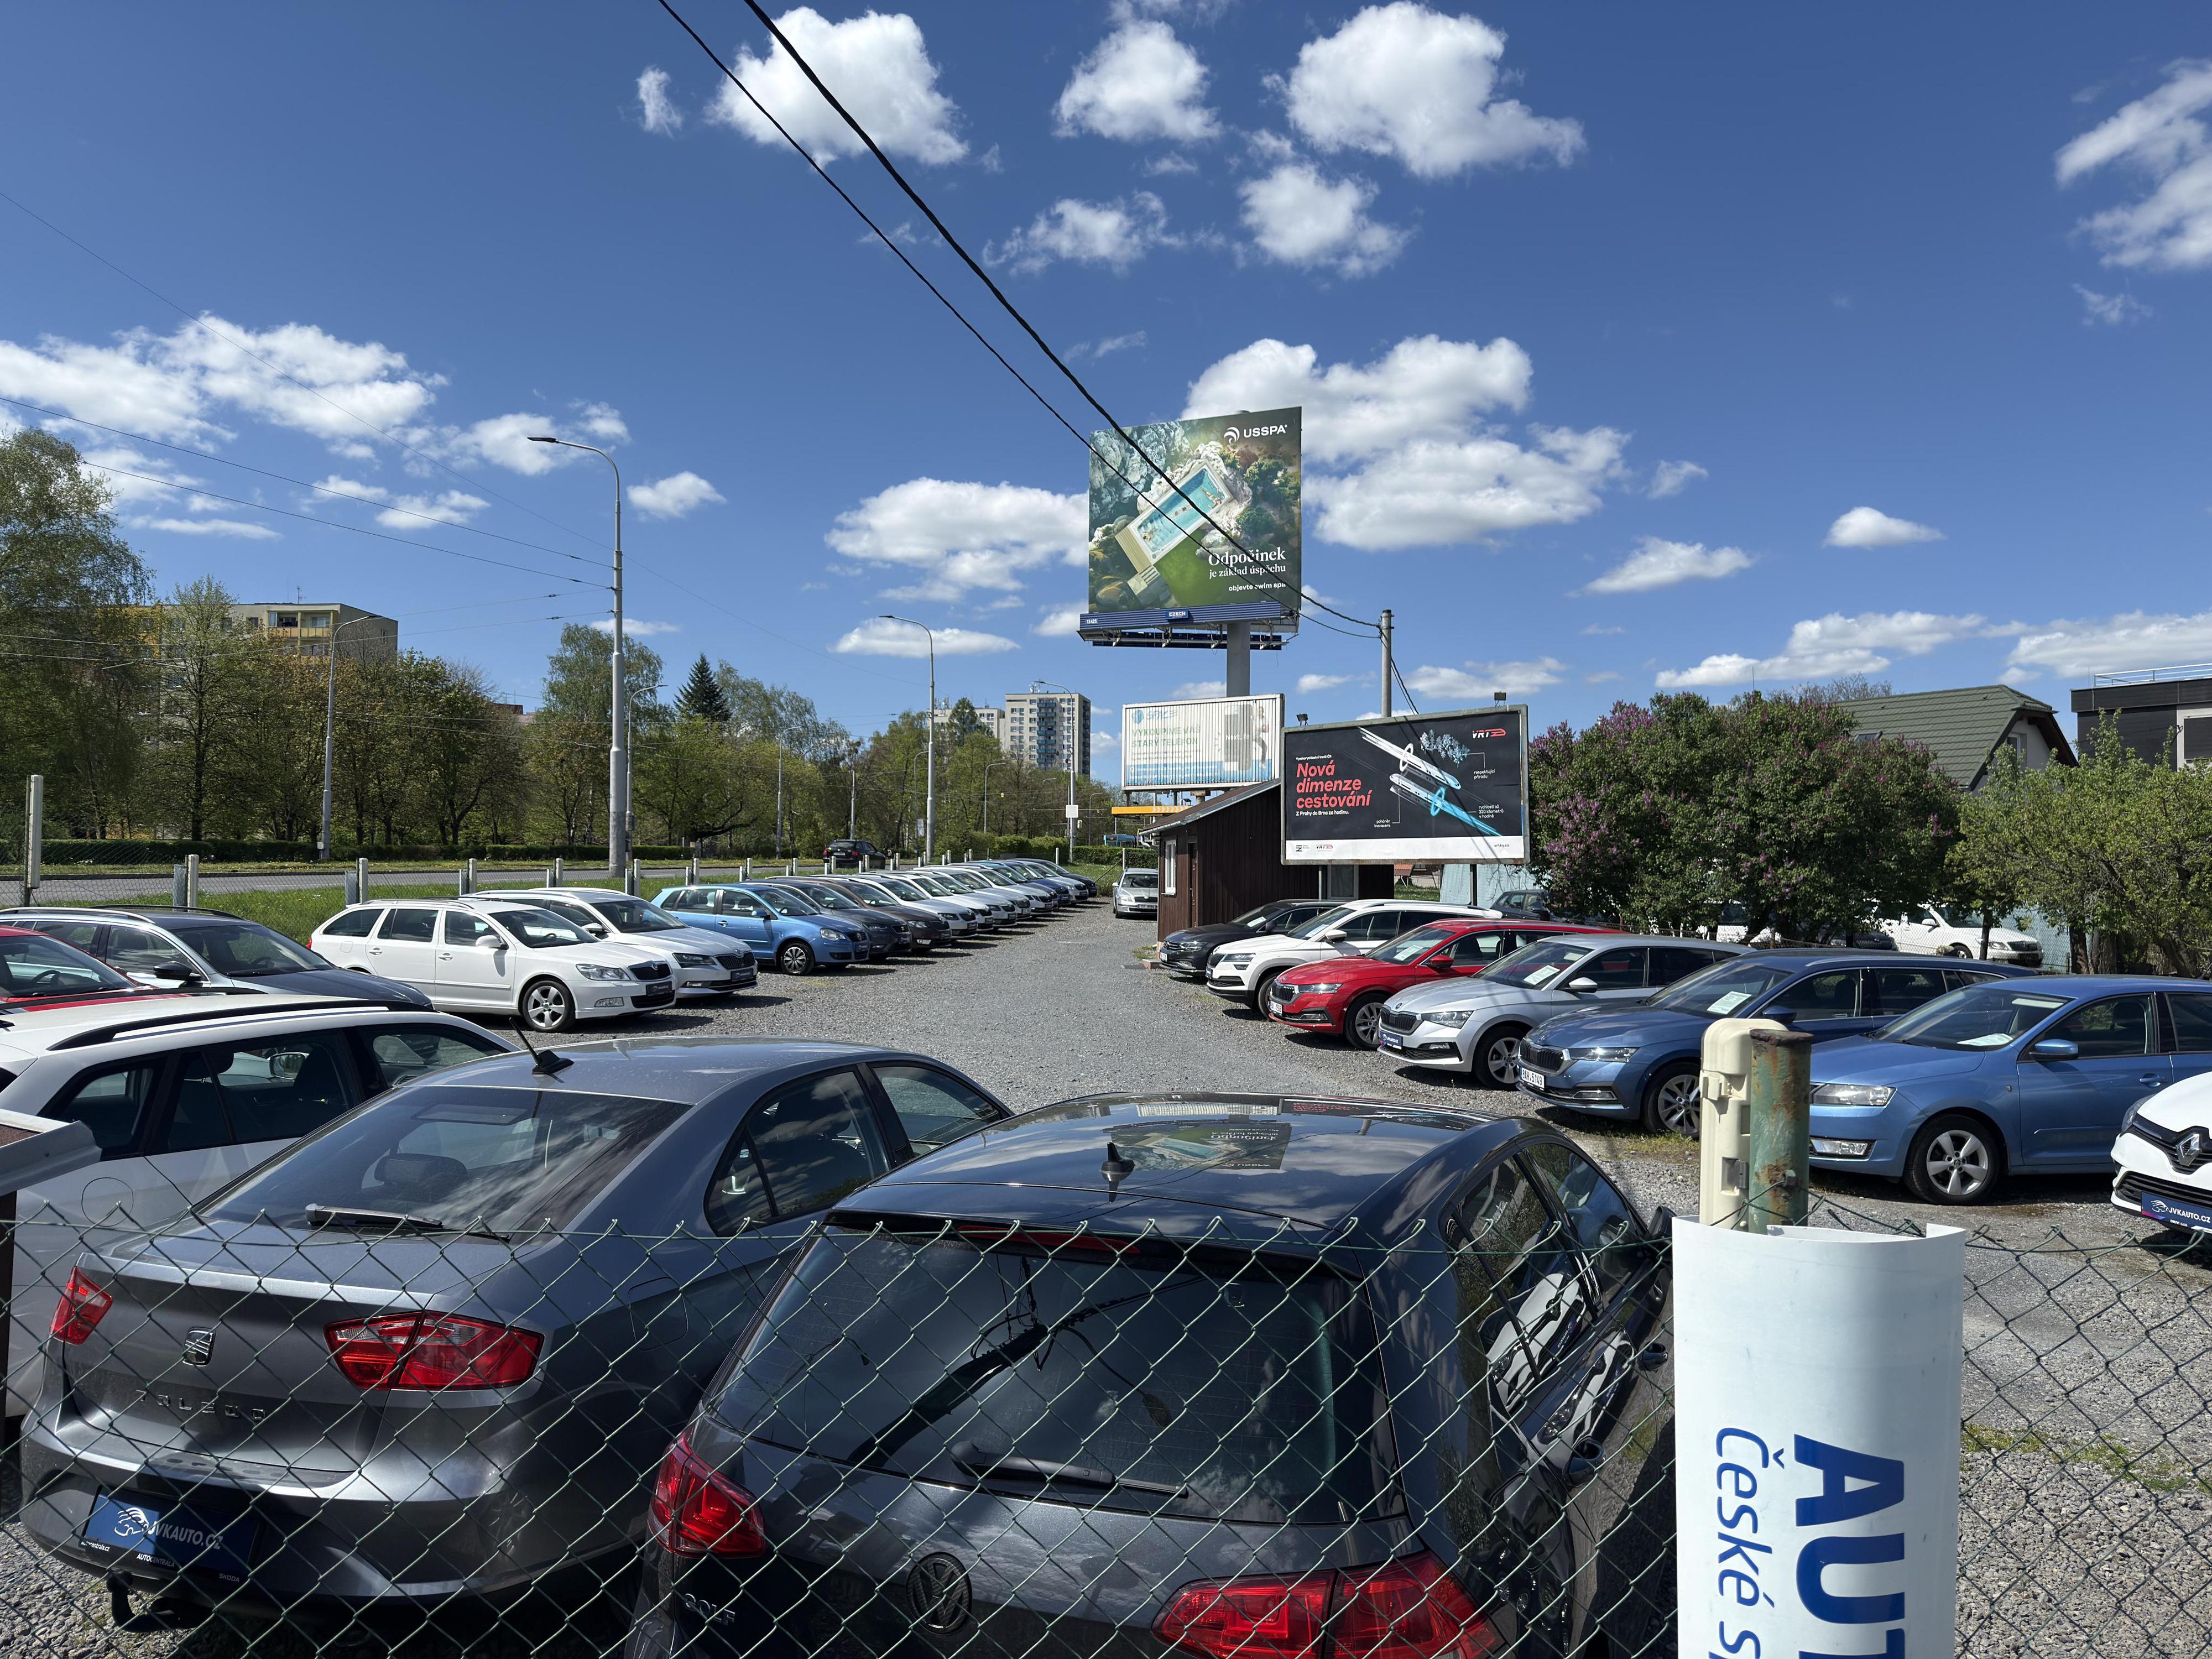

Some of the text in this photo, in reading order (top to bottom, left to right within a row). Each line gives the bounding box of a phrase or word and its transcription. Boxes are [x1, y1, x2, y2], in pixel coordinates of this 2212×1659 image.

[1243, 425, 1286, 438] USSPA
[1209, 570, 1217, 579] je
[1219, 566, 1248, 577] základ
[1296, 760, 1335, 778] Nová
[1296, 778, 1361, 793] dimenze
[1296, 790, 1373, 809] cestování
[2168, 1207, 2211, 1223] JVKAUTO.CZ
[1708, 1427, 1785, 1659] České s
